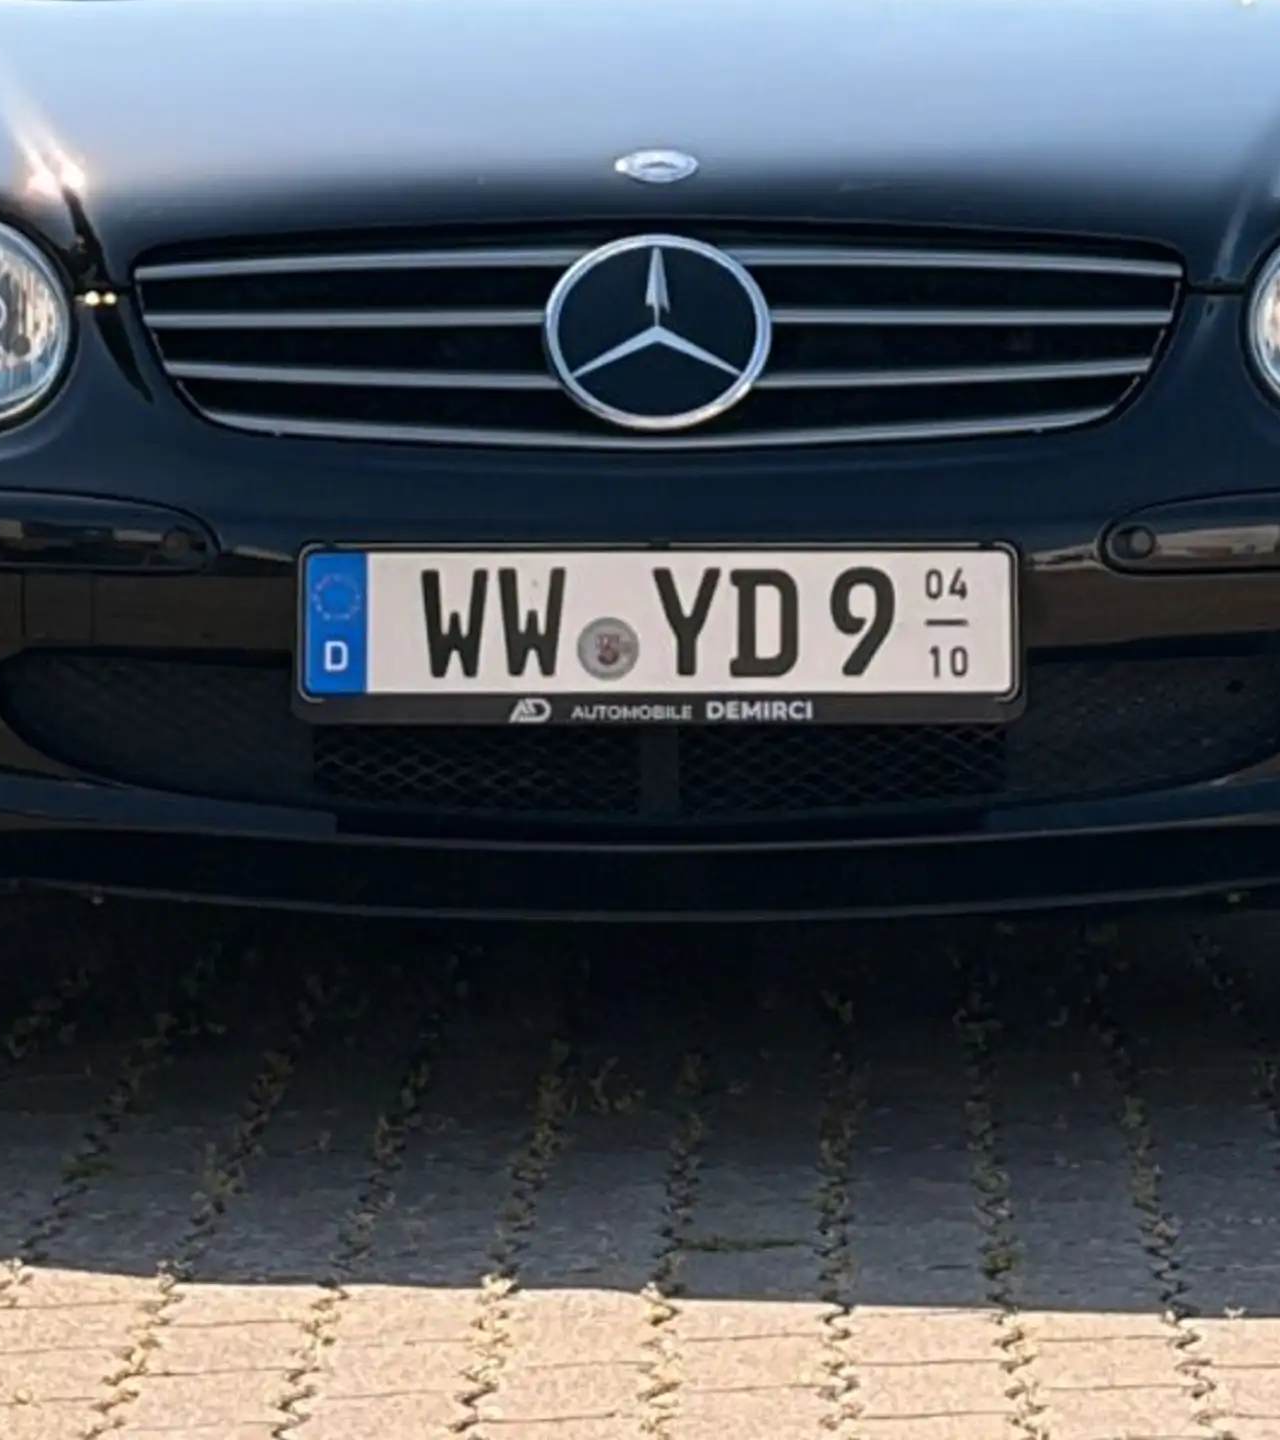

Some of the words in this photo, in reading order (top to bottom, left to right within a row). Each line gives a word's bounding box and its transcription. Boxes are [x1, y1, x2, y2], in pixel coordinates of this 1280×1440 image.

[924, 569, 969, 600] 04
[421, 568, 566, 678] WW
[652, 568, 799, 678] YD
[829, 567, 897, 677] 9
[323, 641, 348, 671] D
[928, 645, 970, 677] 10
[570, 705, 693, 721] AUTOMOBILE
[705, 700, 814, 721] DEMIRCI
